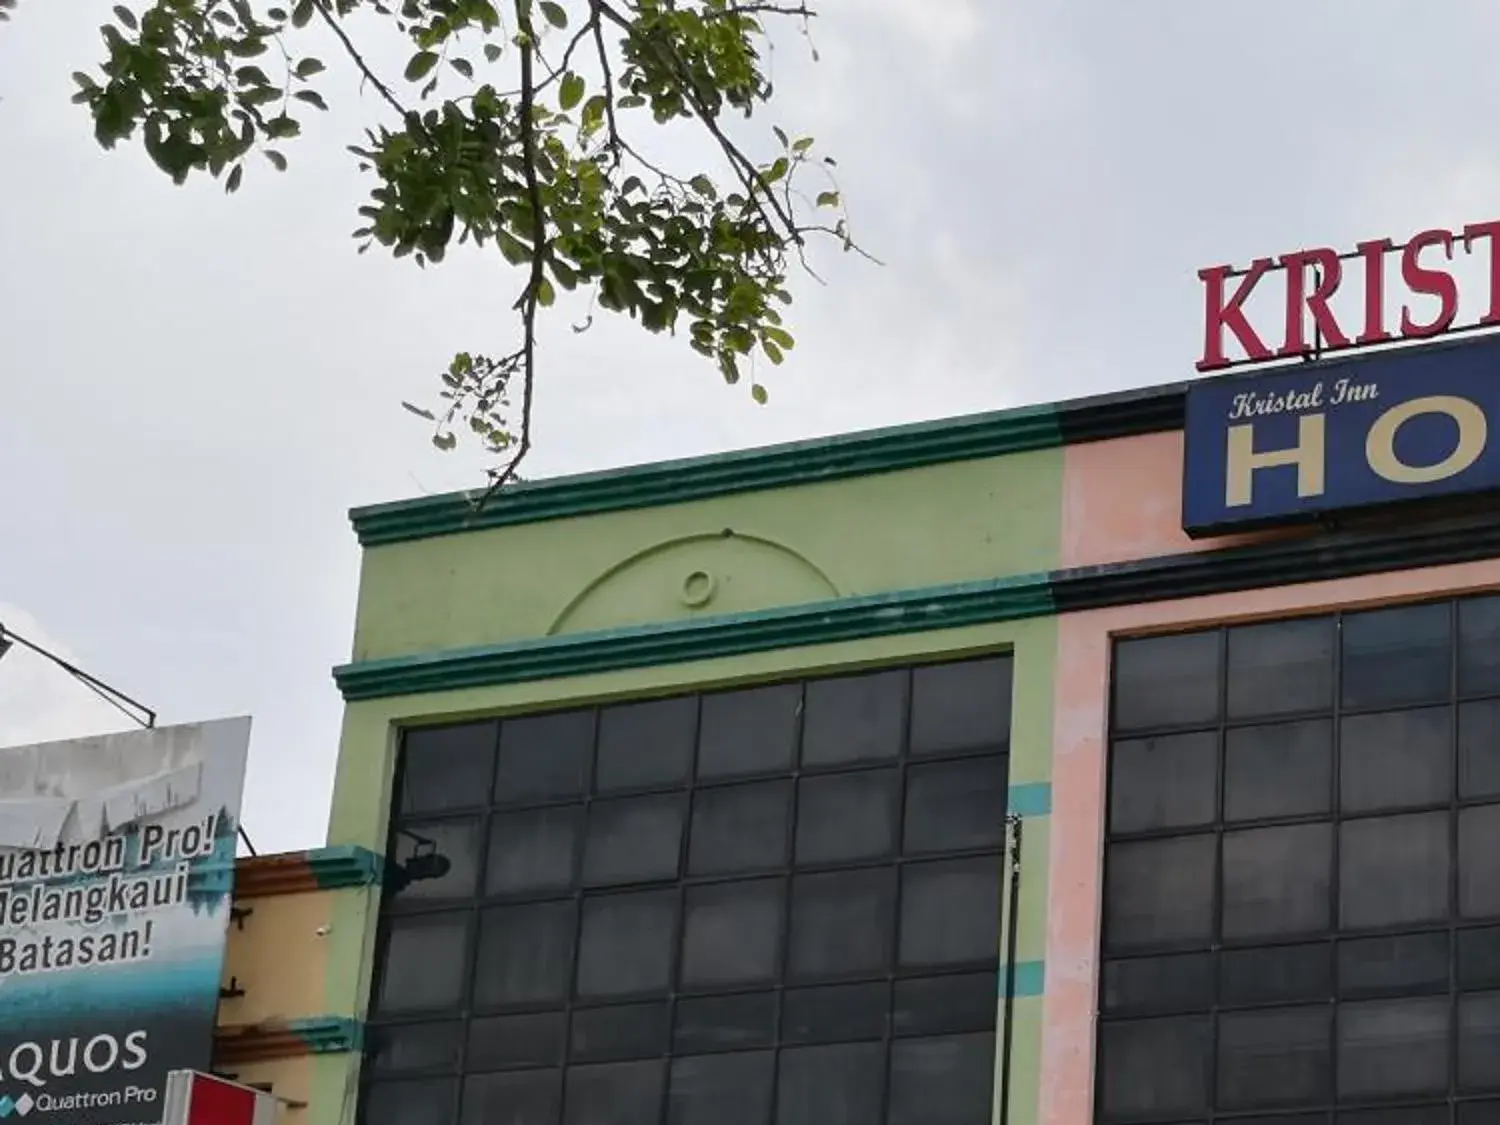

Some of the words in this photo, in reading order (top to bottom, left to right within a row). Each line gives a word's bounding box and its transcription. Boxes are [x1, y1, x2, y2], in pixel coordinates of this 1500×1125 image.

[1229, 381, 1324, 419] Kristal
[1330, 378, 1380, 404] Inn
[140, 815, 215, 862] Pro!
[0, 920, 152, 973] Batasan!
[0, 1029, 148, 1087] QUOS
[36, 1090, 121, 1112] Quattron
[125, 1085, 157, 1103] Pro
